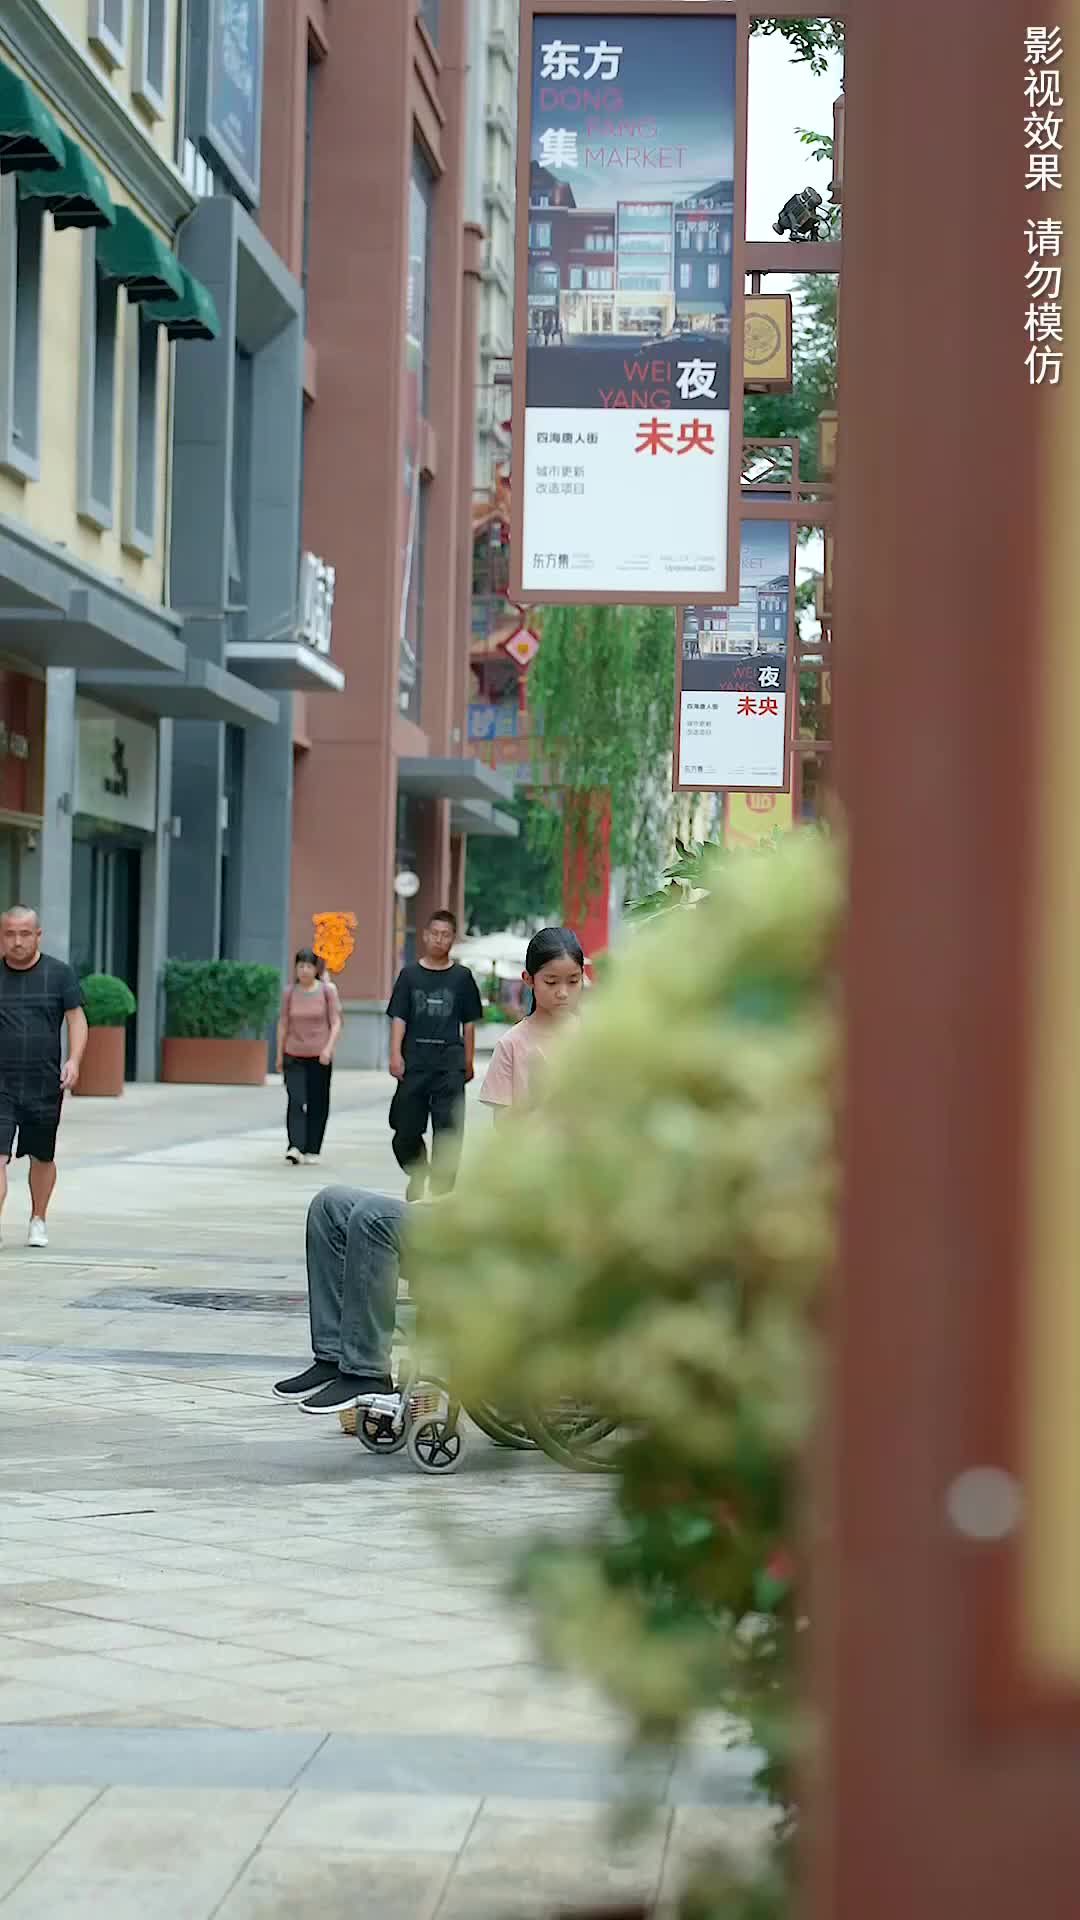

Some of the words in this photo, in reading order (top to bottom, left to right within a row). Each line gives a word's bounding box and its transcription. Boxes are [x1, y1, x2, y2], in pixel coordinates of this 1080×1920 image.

[540, 40, 623, 80] 东方
[540, 87, 623, 112] DONG
[584, 117, 657, 138] FANG
[538, 128, 578, 168] 集
[584, 146, 687, 169] MARKET
[624, 360, 671, 382] WEI
[675, 358, 718, 399] 夜
[599, 389, 671, 409] YANG
[536, 431, 598, 444] 四海唐人街
[634, 417, 714, 455] 未央
[532, 553, 569, 569] 东方集
[758, 666, 780, 687] 夜
[737, 696, 778, 716] 未央
